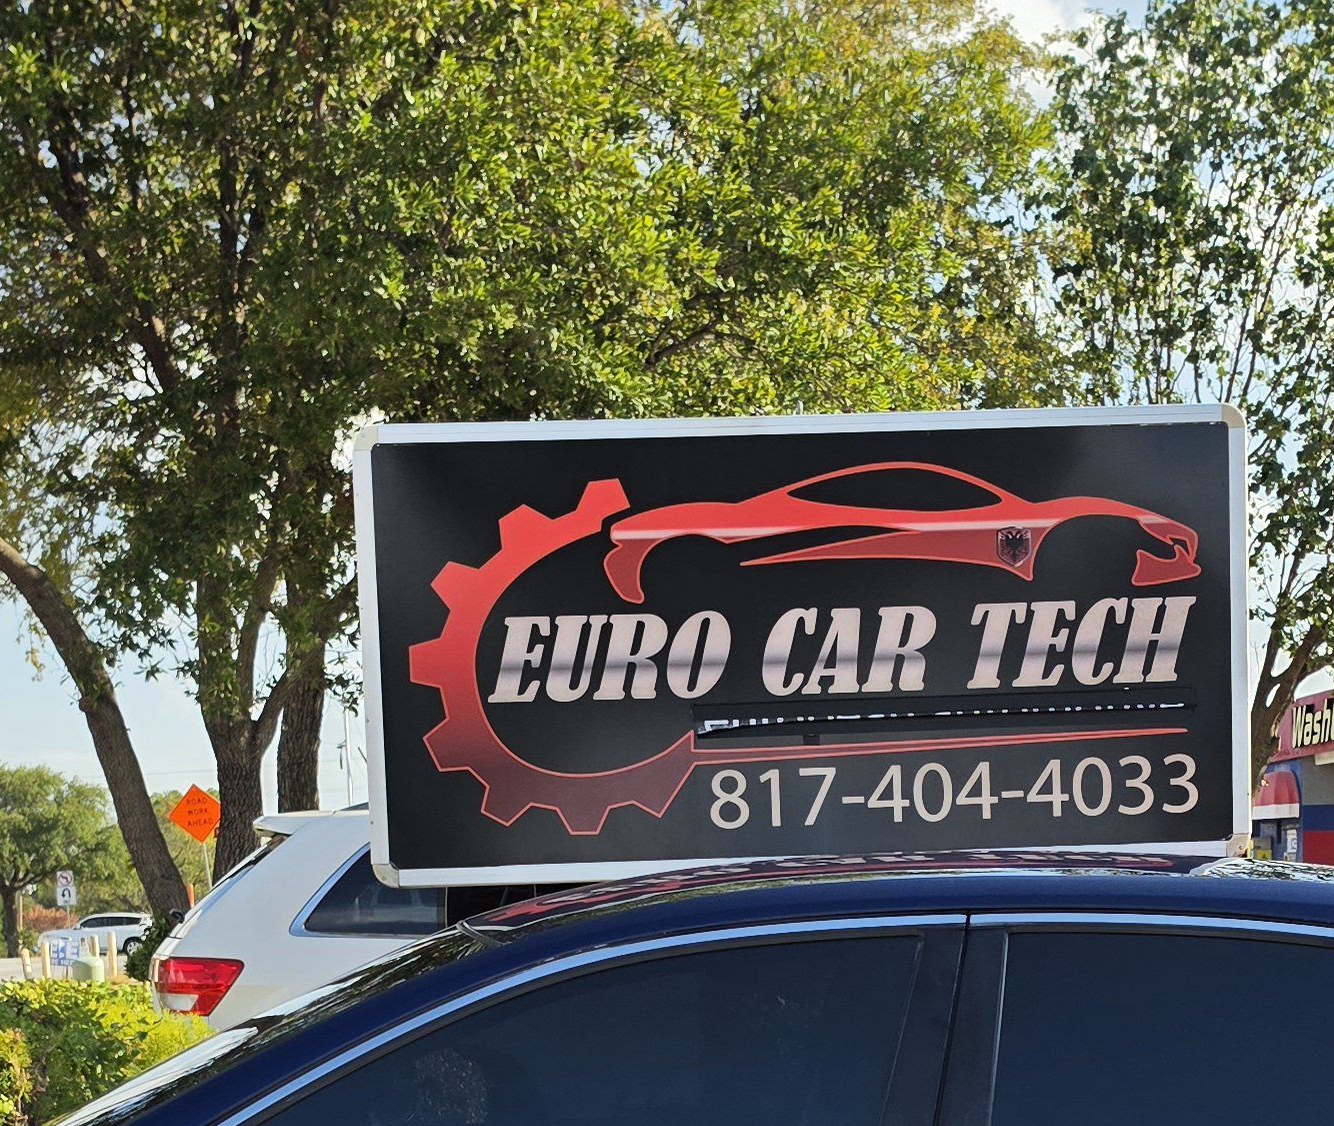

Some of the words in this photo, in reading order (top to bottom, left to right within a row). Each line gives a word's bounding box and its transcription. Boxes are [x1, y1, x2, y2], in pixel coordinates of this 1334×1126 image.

[488, 611, 732, 704] EURO
[762, 606, 937, 697] CAR
[967, 596, 1197, 690] TECH
[709, 753, 1199, 830] 817-404-4033
[186, 797, 207, 805] ROAD
[188, 808, 209, 816] WORK
[188, 818, 213, 827] AHEAD
